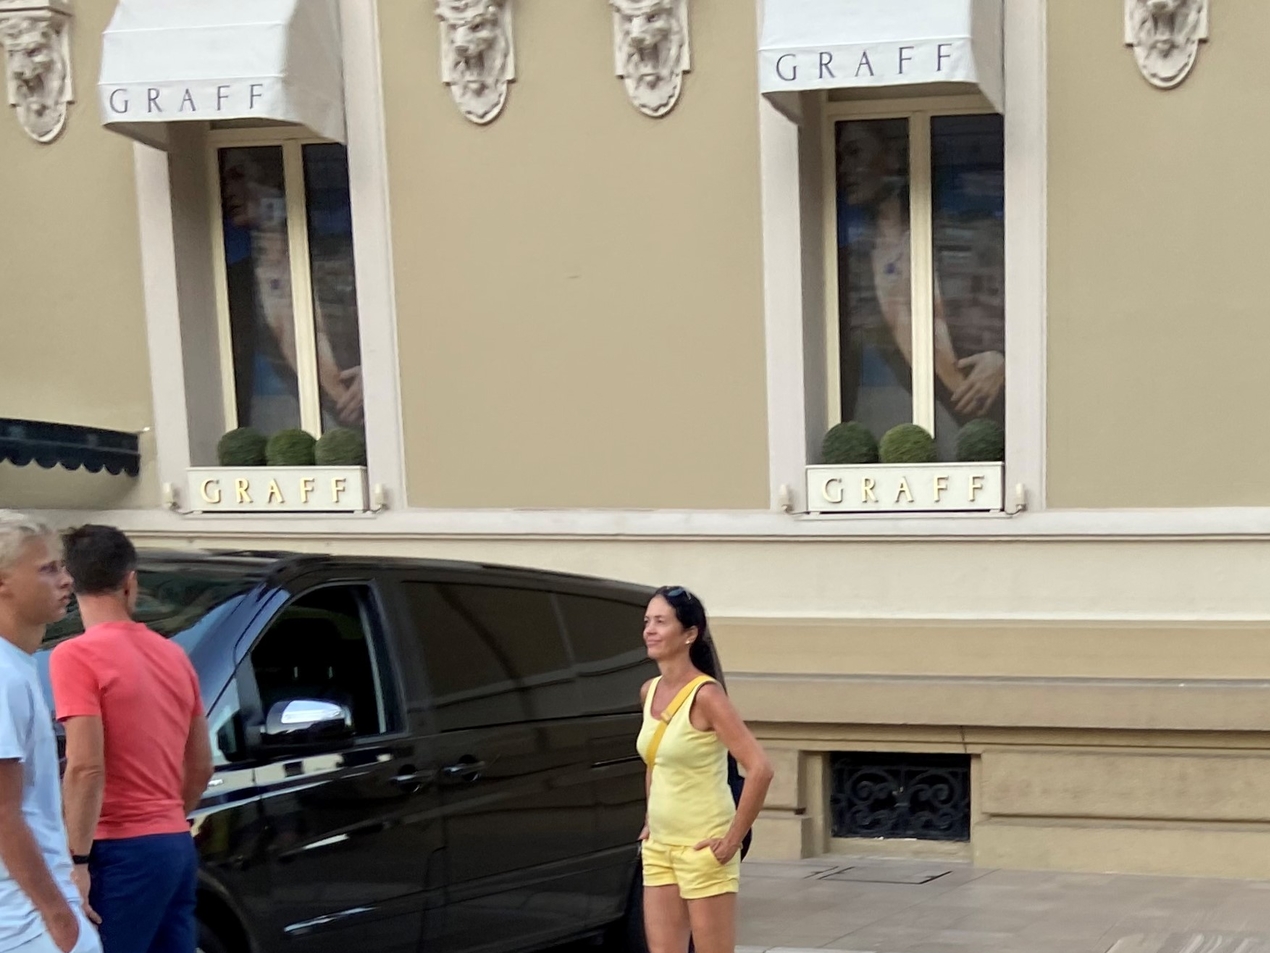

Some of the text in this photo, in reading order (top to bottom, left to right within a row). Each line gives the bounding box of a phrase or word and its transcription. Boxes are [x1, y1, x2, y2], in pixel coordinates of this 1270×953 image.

[776, 43, 952, 82] GRAFF
[109, 83, 263, 114] GRAFF
[200, 477, 347, 504] GRAFF
[822, 475, 985, 504] GRAFF
